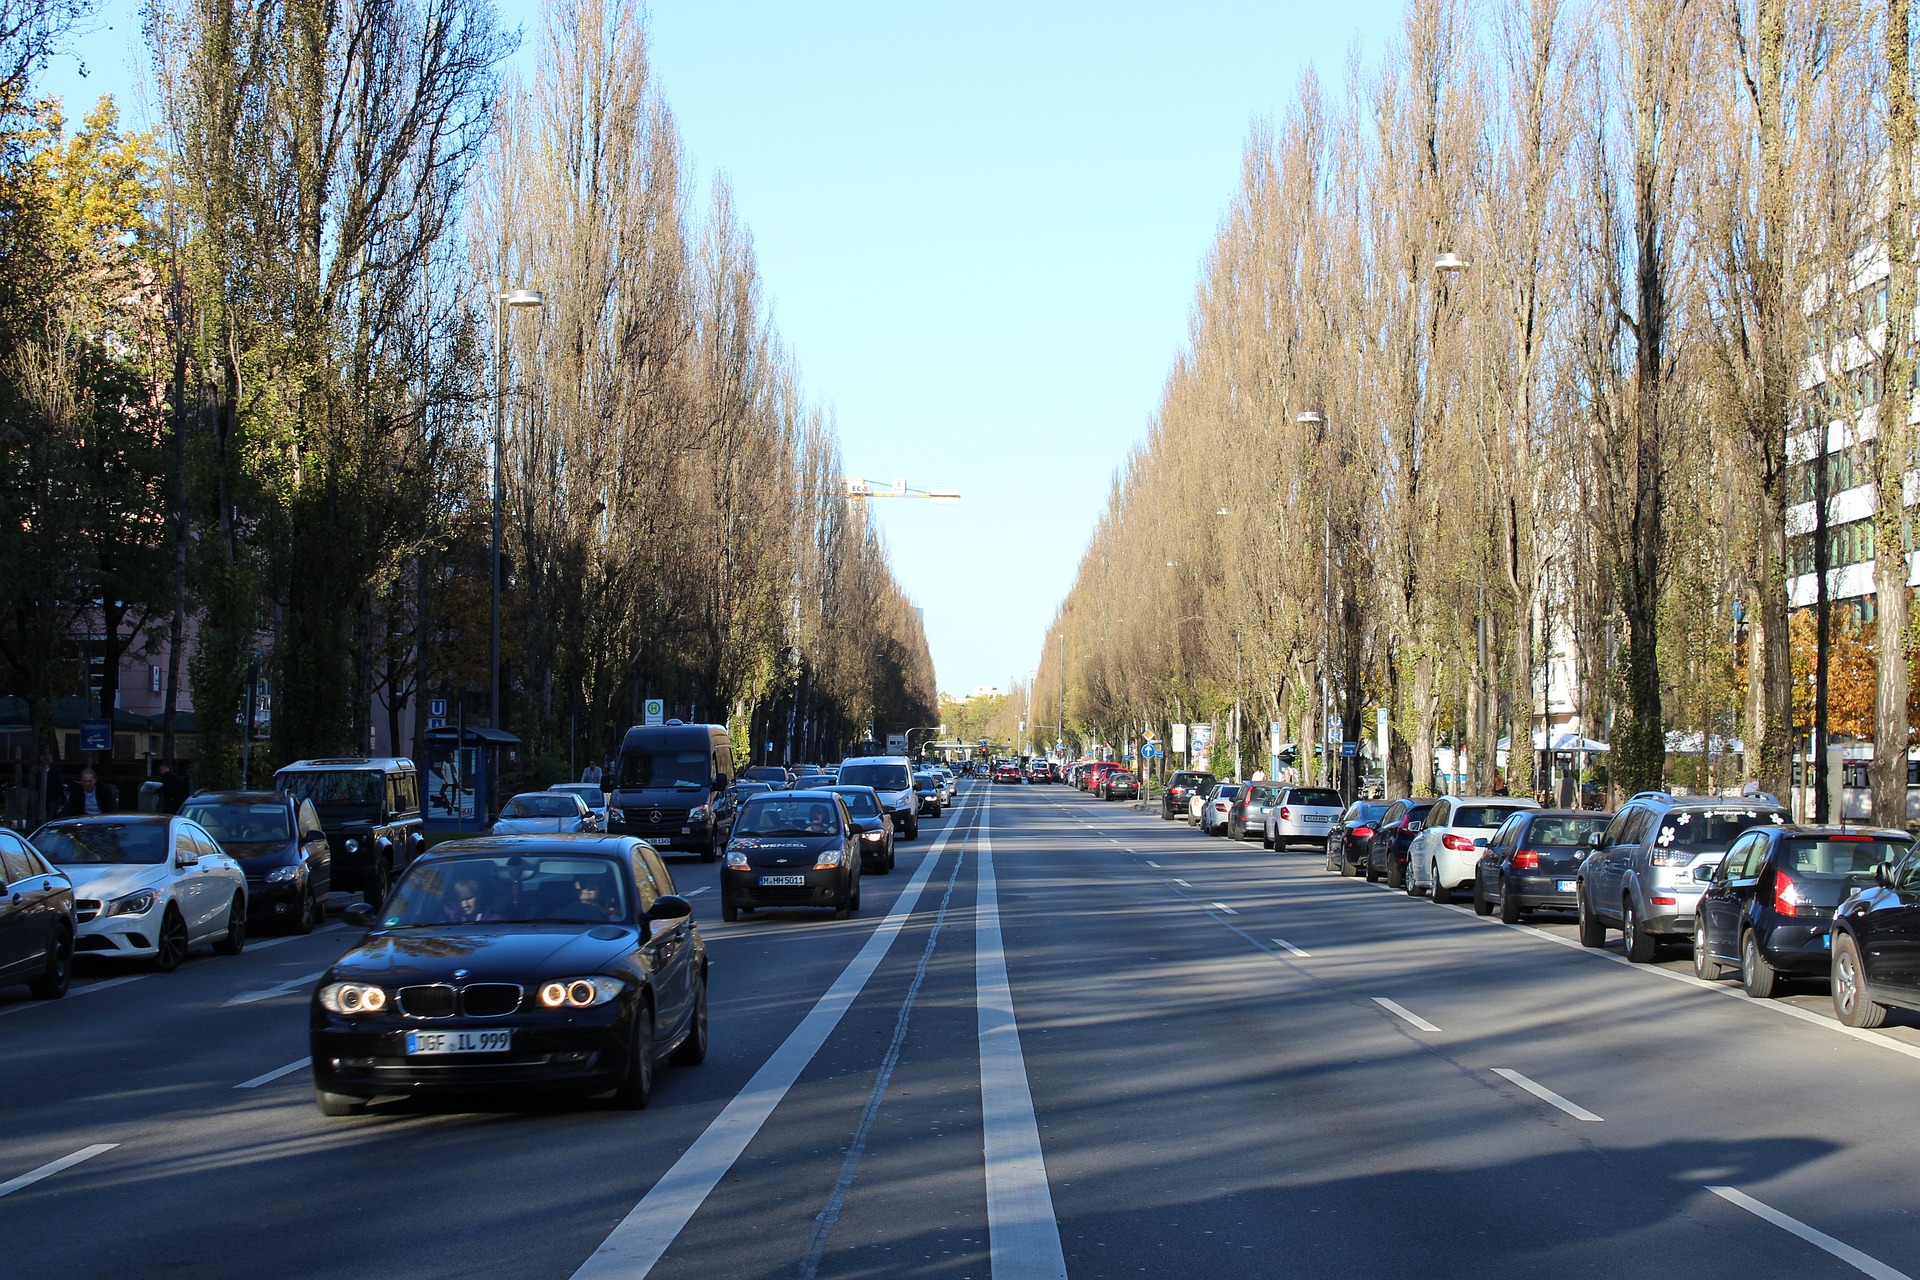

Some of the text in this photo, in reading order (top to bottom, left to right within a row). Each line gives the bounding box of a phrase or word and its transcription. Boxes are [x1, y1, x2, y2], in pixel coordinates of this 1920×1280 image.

[432, 702, 443, 715] U
[417, 1032, 508, 1051] DGF IL 999
